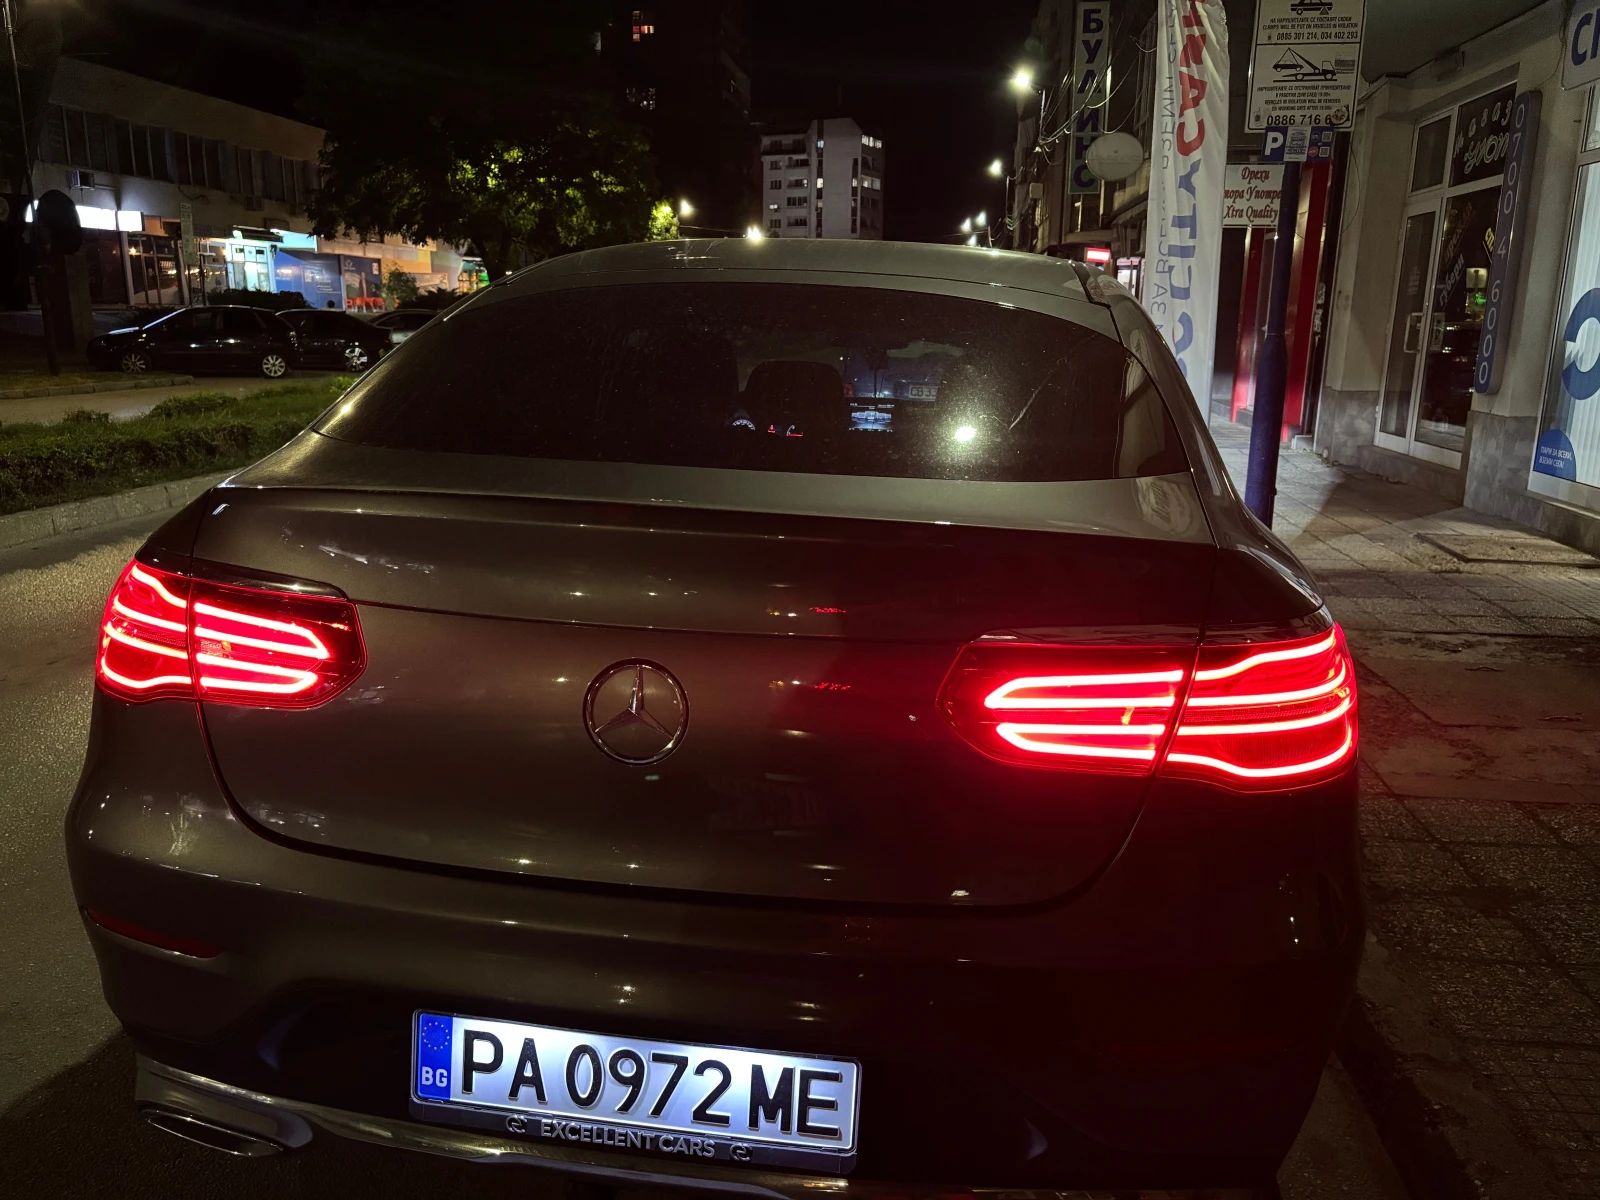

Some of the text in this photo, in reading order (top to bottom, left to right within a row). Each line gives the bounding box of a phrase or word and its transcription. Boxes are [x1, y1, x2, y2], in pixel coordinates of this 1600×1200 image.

[1294, 32, 1304, 40] 301
[1320, 31, 1332, 40] 034
[1334, 31, 1345, 39] 402
[1346, 31, 1358, 39] 293
[1266, 115, 1296, 126] 0886
[1300, 114, 1321, 124] 716
[1264, 132, 1284, 156] P
[1241, 166, 1270, 184] Дрехи
[1246, 204, 1278, 223] Quality
[421, 1066, 448, 1088] BG
[462, 1029, 843, 1141] PA 0972 ME
[540, 1119, 716, 1158] EXCELLENT CARS
